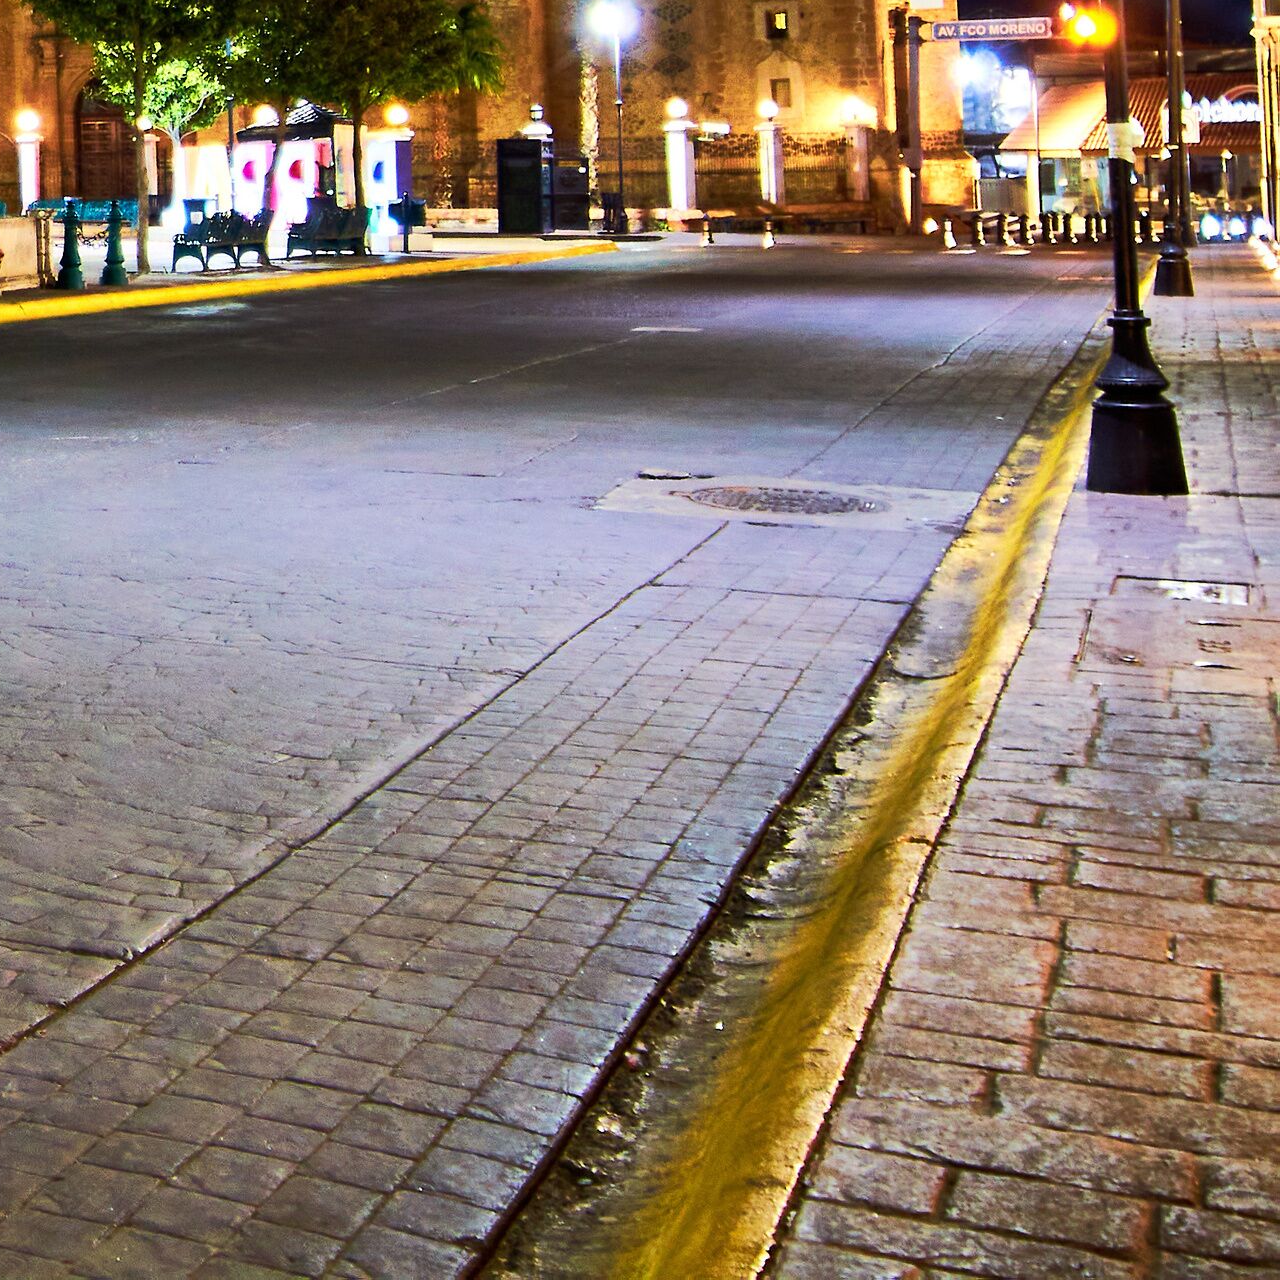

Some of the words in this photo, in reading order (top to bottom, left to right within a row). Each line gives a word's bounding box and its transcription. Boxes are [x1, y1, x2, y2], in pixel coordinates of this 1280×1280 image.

[938, 26, 957, 37] AV.
[960, 25, 986, 36] FCO
[989, 22, 1046, 35] MORENO
